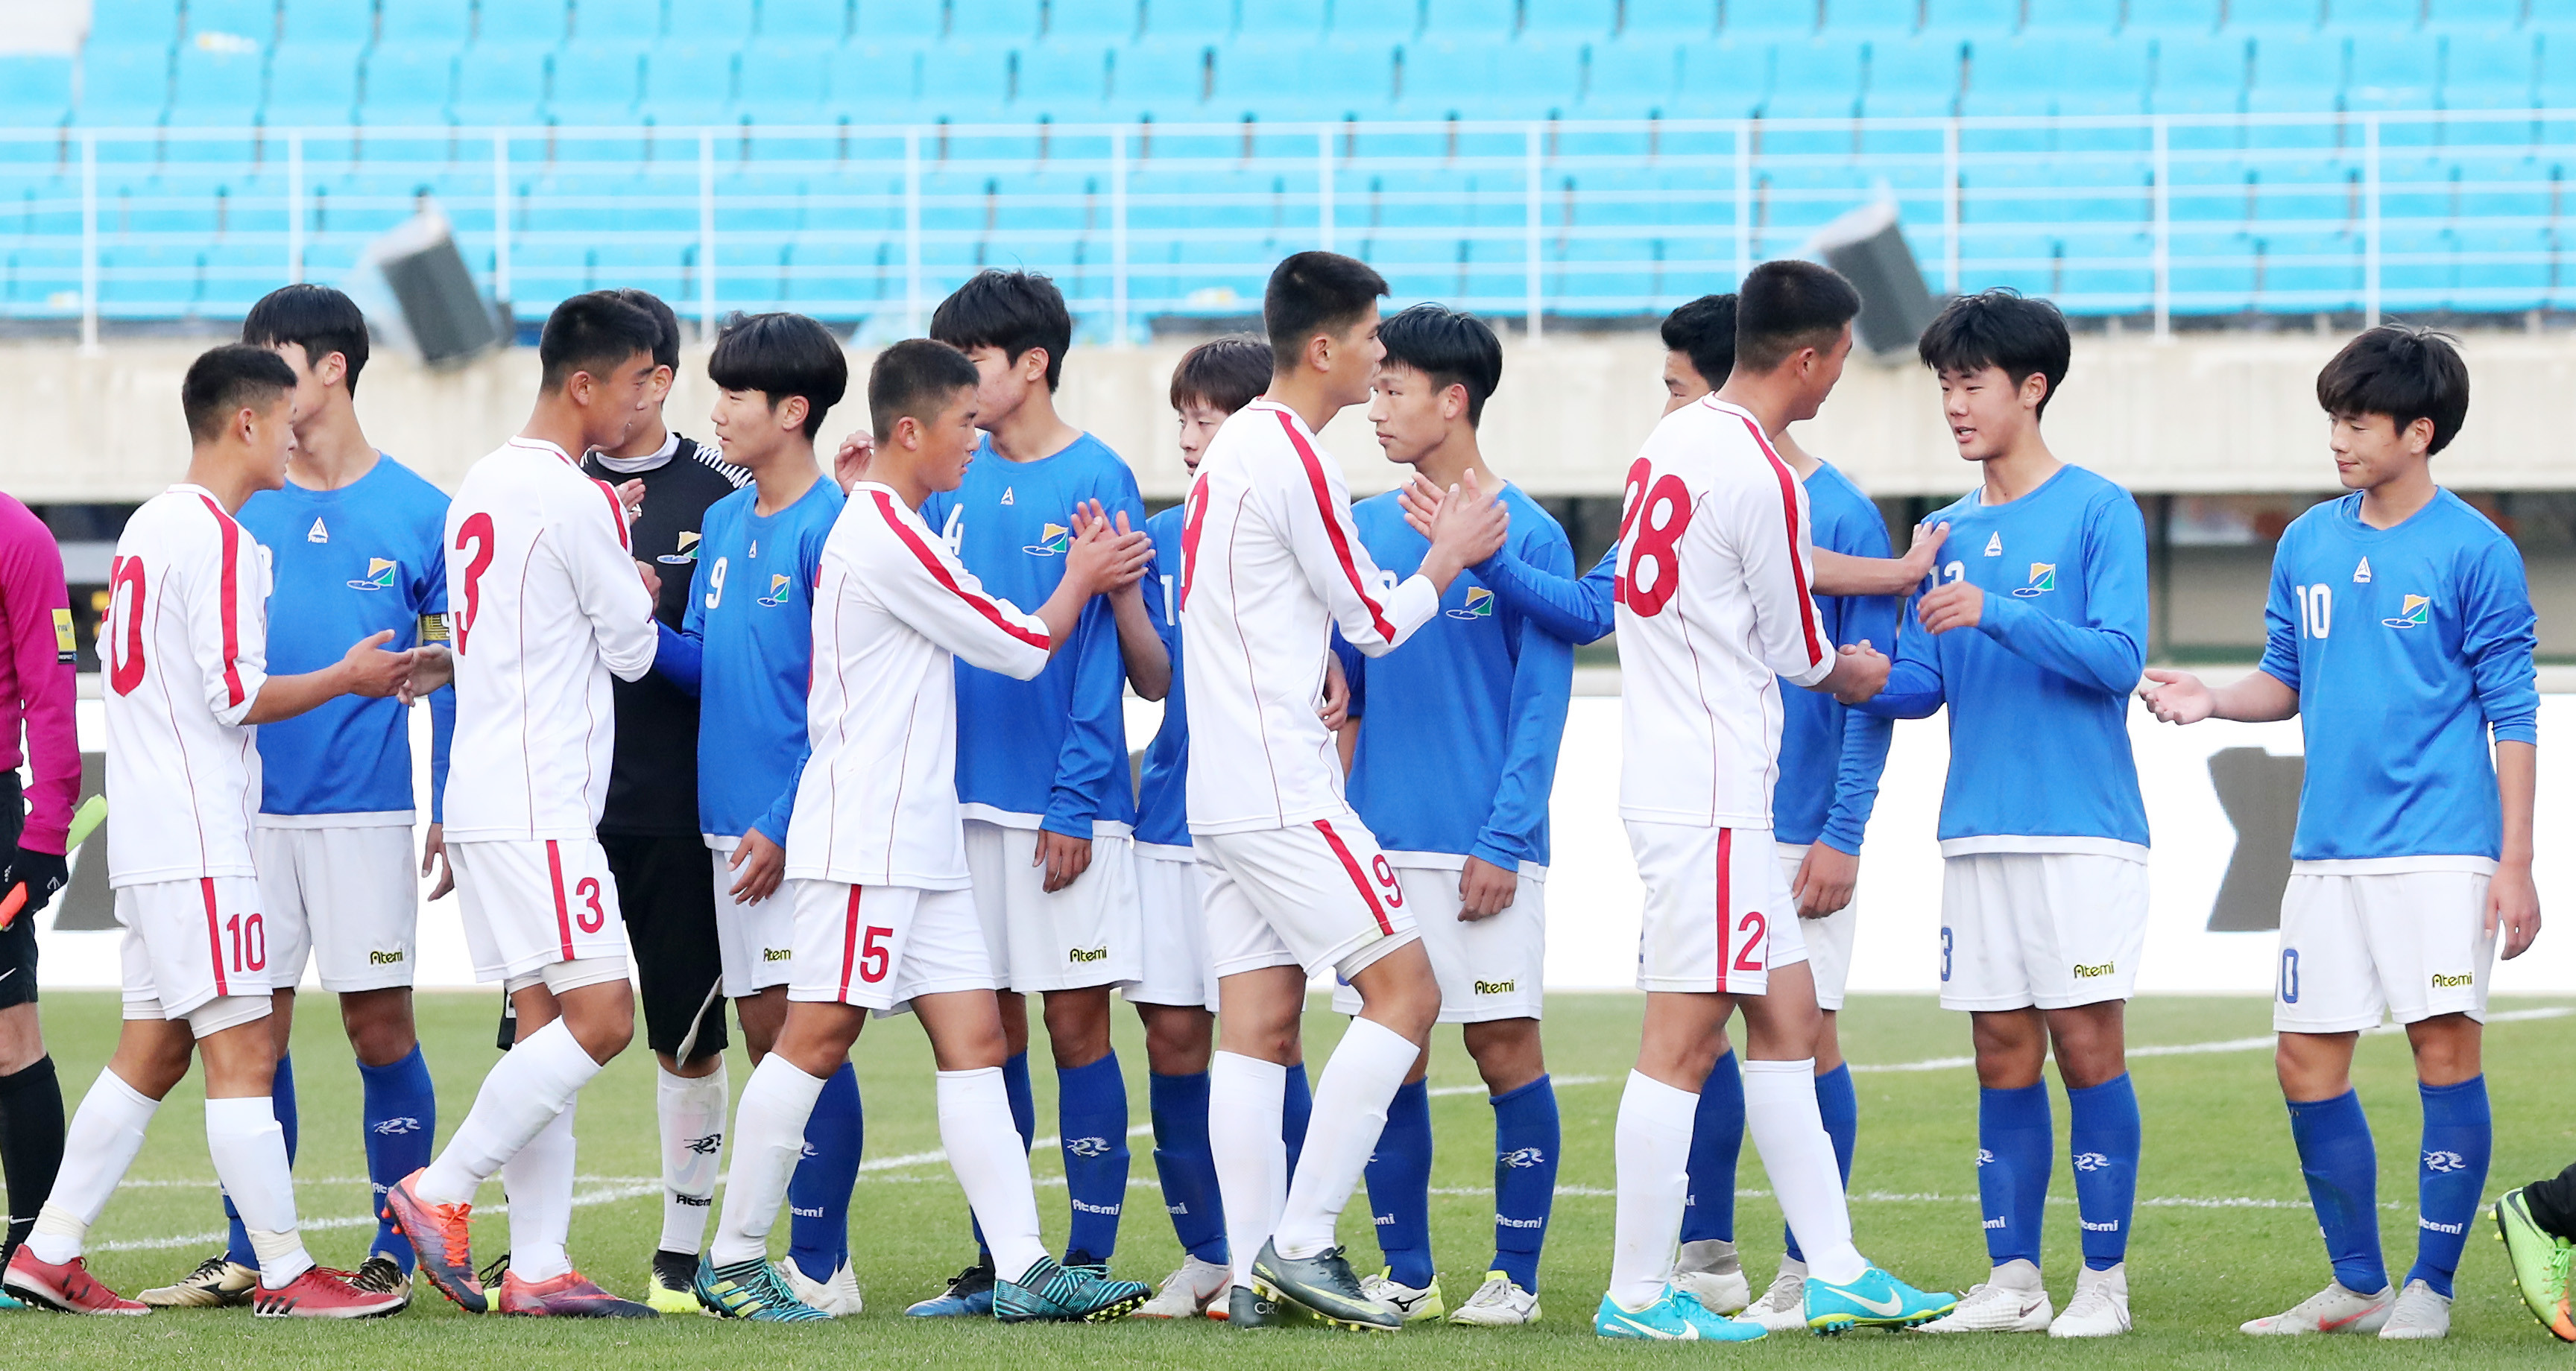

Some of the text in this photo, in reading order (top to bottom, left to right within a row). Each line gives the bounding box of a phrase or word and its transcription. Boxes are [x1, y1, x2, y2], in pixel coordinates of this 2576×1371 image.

[942, 502, 964, 556] 4
[1614, 457, 1691, 618] 28
[455, 512, 494, 656] 3
[705, 557, 727, 609] 9
[2296, 583, 2332, 639] 10
[575, 877, 604, 934] 3
[1372, 854, 1404, 908] 9
[227, 913, 266, 972] 10
[370, 948, 403, 965] Atemi
[859, 925, 894, 984] 5
[1070, 946, 1107, 962] Atemi
[1733, 911, 1770, 971] 2
[1940, 927, 1953, 982] 3
[1475, 979, 1515, 995] Atemi
[2074, 960, 2115, 978] Atemi
[2276, 948, 2299, 1004] 0
[2432, 972, 2472, 988] Atemi
[676, 1194, 713, 1206] Atem
[1073, 1199, 1120, 1215] Atemi
[1495, 1213, 1543, 1229] Atemi
[2080, 1216, 2118, 1232] temi
